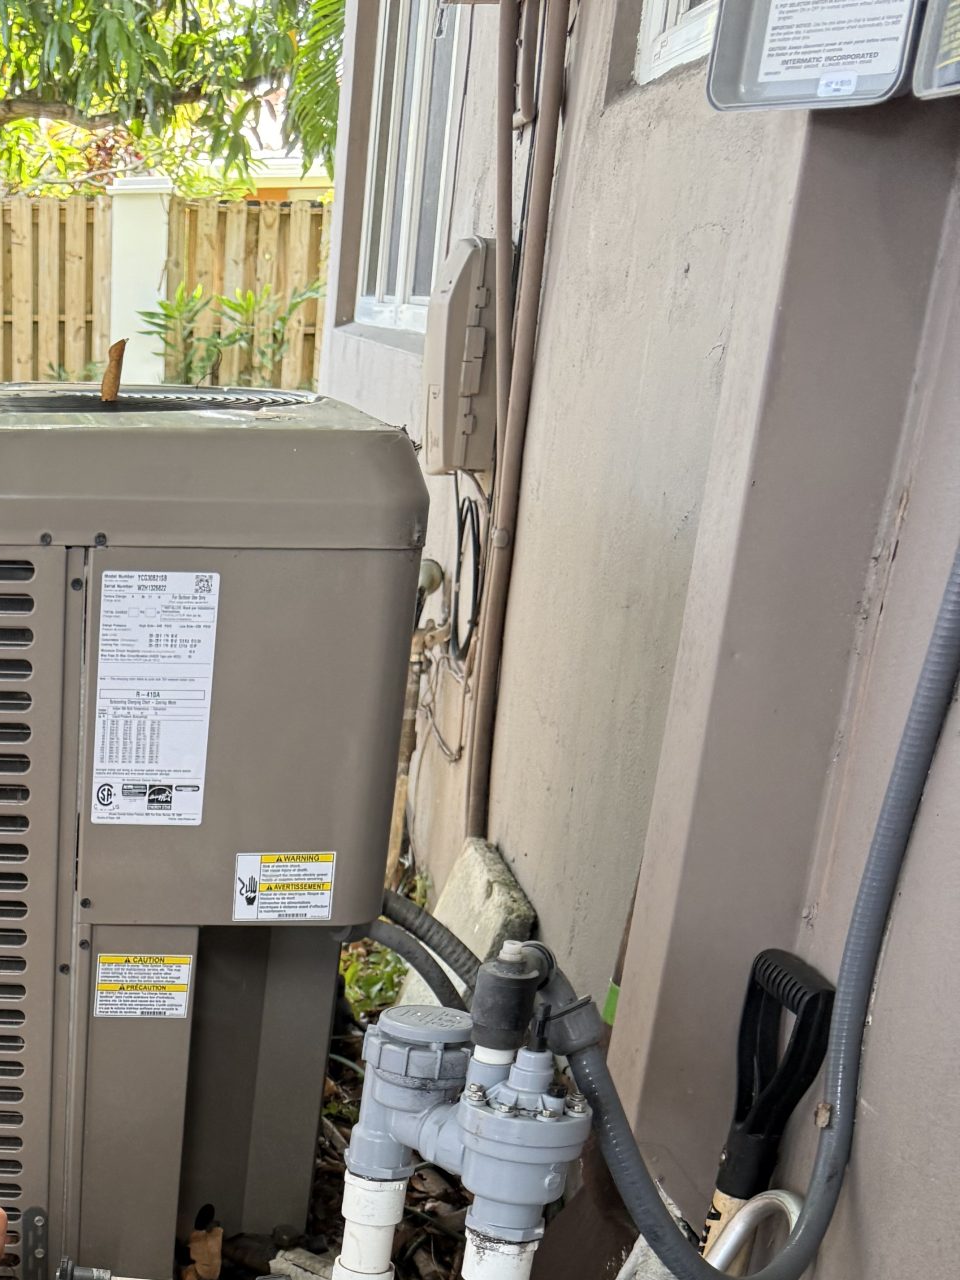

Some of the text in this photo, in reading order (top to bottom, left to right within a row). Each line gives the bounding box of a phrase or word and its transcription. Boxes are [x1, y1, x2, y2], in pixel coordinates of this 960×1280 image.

[781, 51, 880, 66] INTERMATIC INCORPORATED
[284, 854, 320, 862] WARNING
[132, 956, 165, 964] CAUTION
[126, 982, 167, 991] PRÉCAUTION
